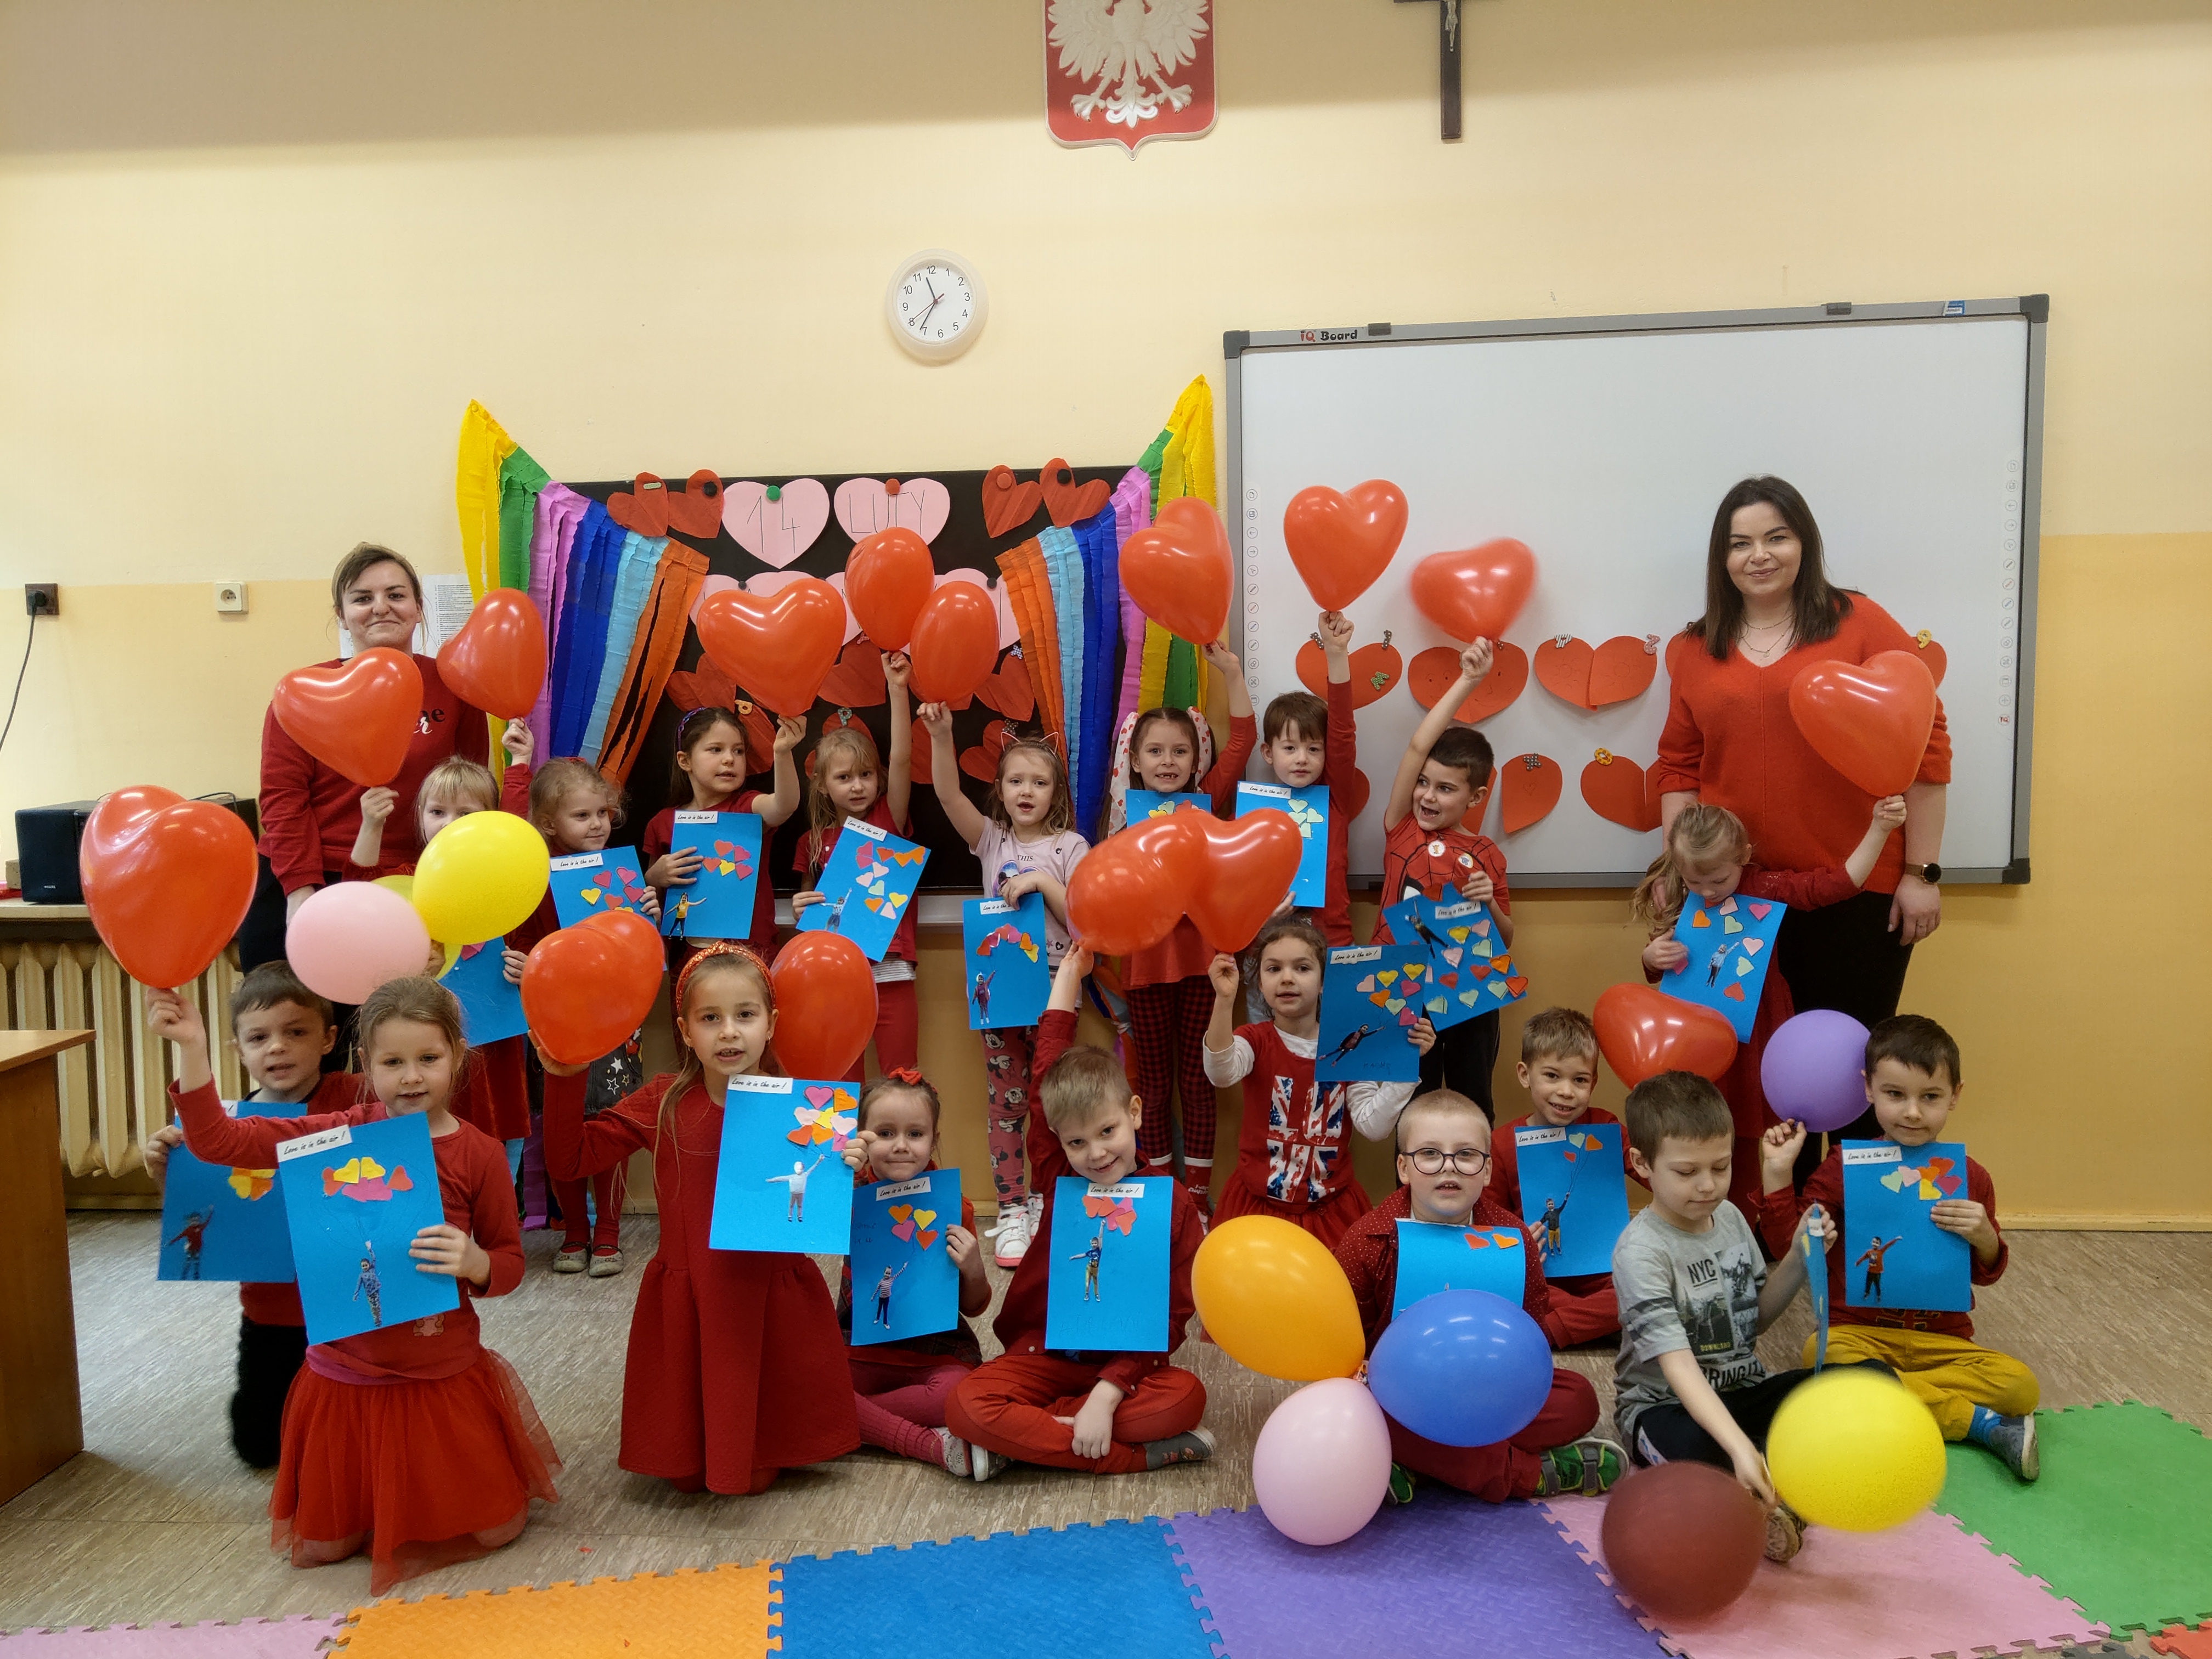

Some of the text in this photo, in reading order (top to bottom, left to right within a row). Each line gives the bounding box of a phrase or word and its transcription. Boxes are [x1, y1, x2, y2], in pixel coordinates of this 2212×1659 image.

[927, 266, 936, 275] 12
[945, 268, 950, 276] 1
[913, 273, 922, 282] 11
[958, 277, 964, 286] 2
[903, 285, 912, 295] 10
[964, 292, 970, 301] 3
[902, 302, 909, 311] 9
[962, 309, 968, 318] 4
[909, 318, 915, 326] 8
[953, 322, 959, 331] 5
[922, 326, 928, 335] 7
[938, 329, 944, 338] 6
[1321, 330, 1358, 341] Board
[747, 489, 925, 554] 14 LUTY
[1687, 1259, 1717, 1284] NYC
